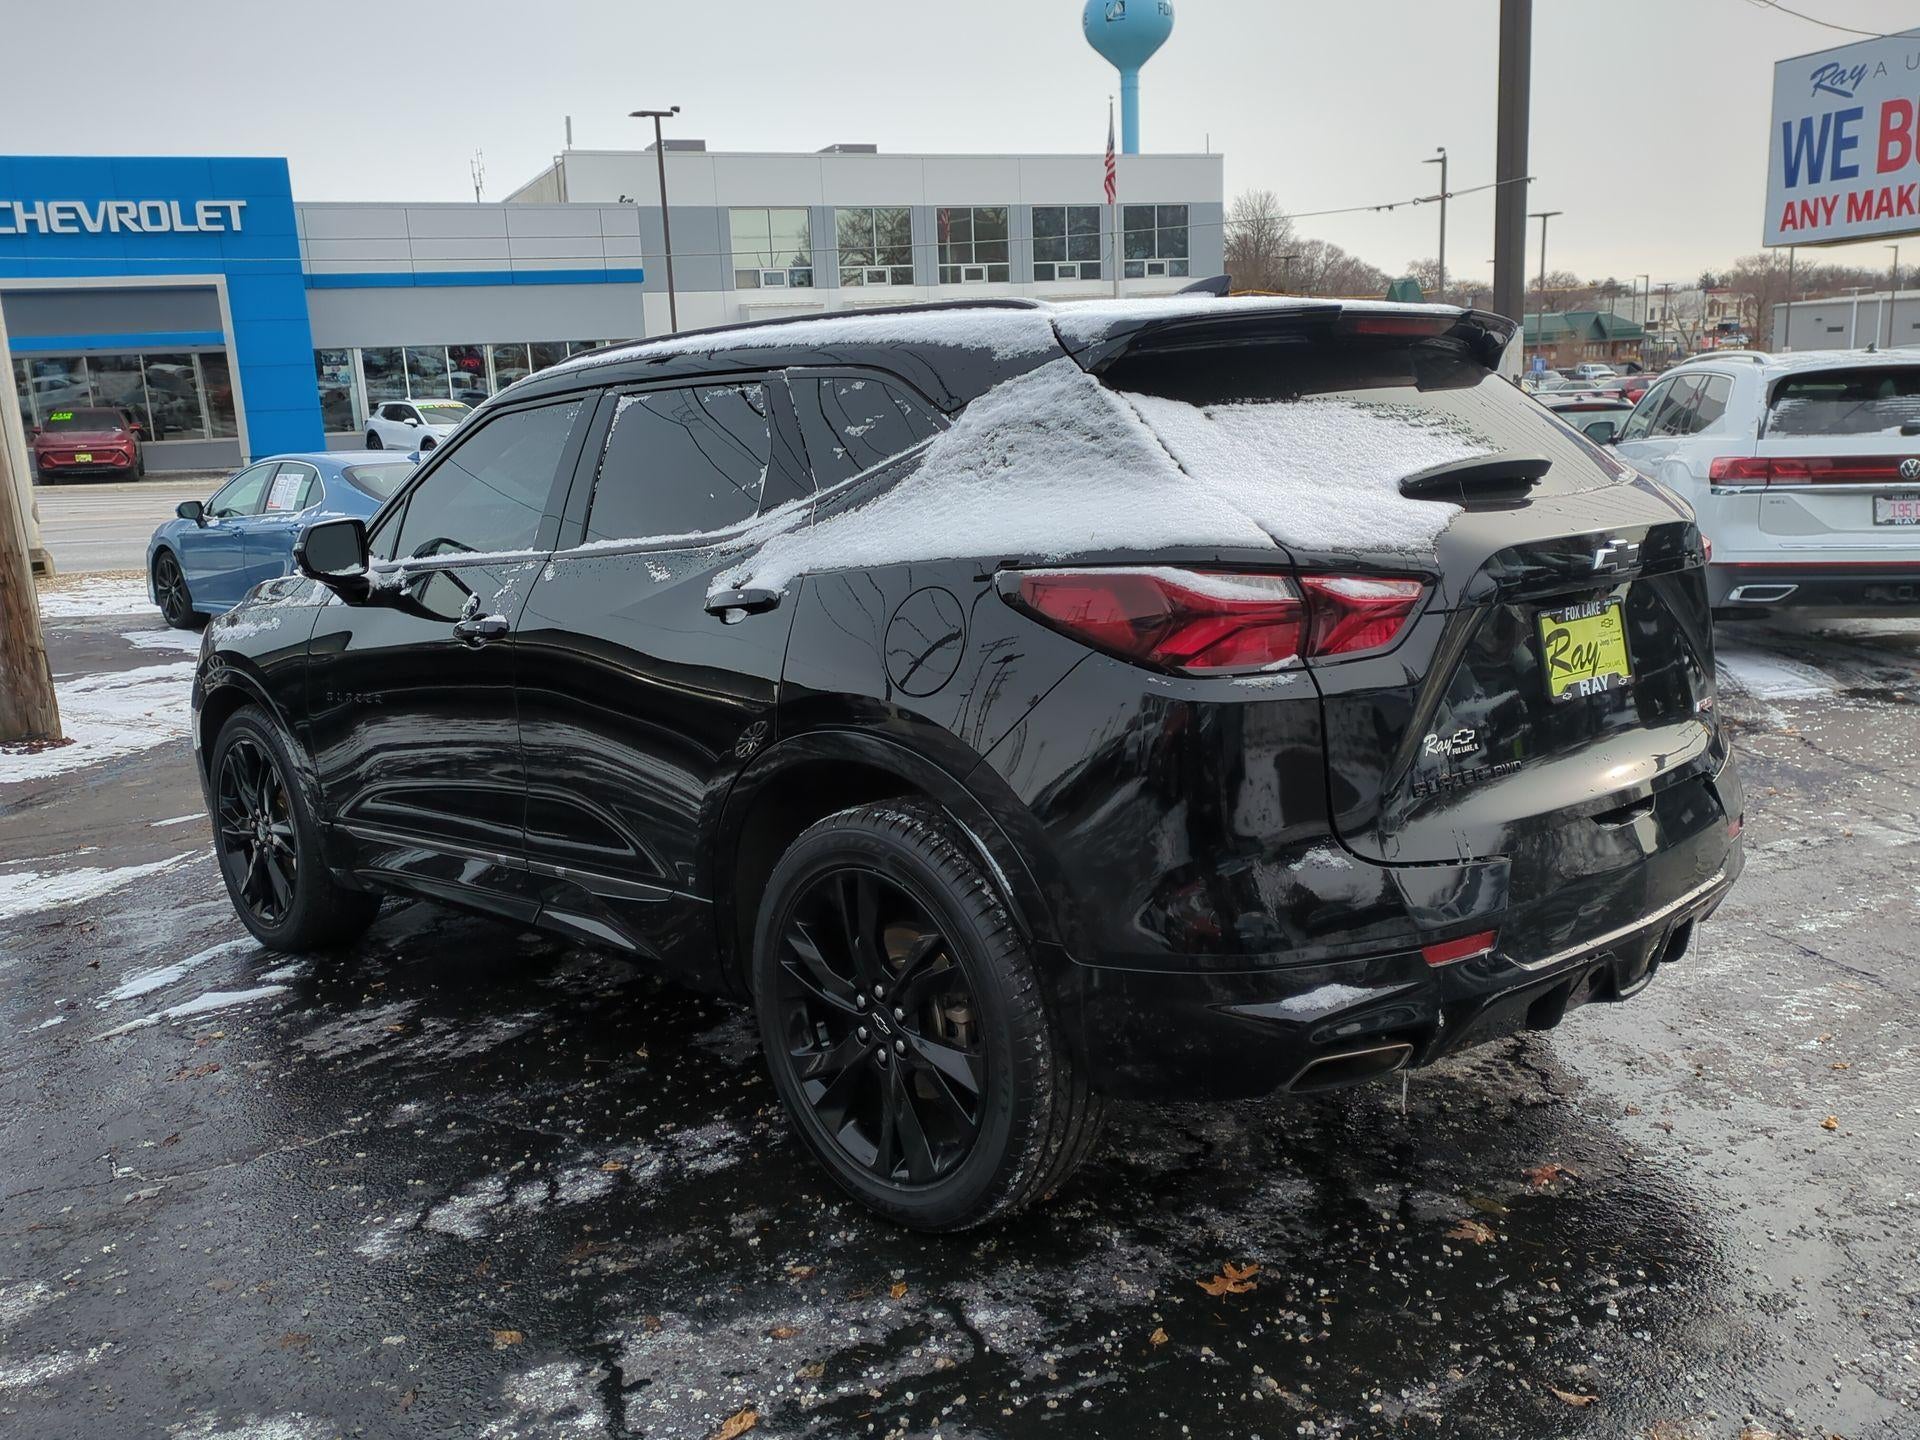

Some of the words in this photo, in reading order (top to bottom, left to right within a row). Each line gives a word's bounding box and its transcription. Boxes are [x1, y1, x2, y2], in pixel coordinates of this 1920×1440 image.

[1810, 62, 1868, 98] Ray
[1782, 106, 1864, 189] WE
[1876, 98, 1920, 174] B
[1780, 194, 1840, 232] ANY
[1846, 182, 1920, 225] MAK
[1565, 606, 1580, 621] FOX
[1582, 602, 1601, 617] LAKE
[1545, 628, 1601, 679] Ray
[1580, 674, 1609, 697] RAY
[1423, 733, 1453, 757] Ray
